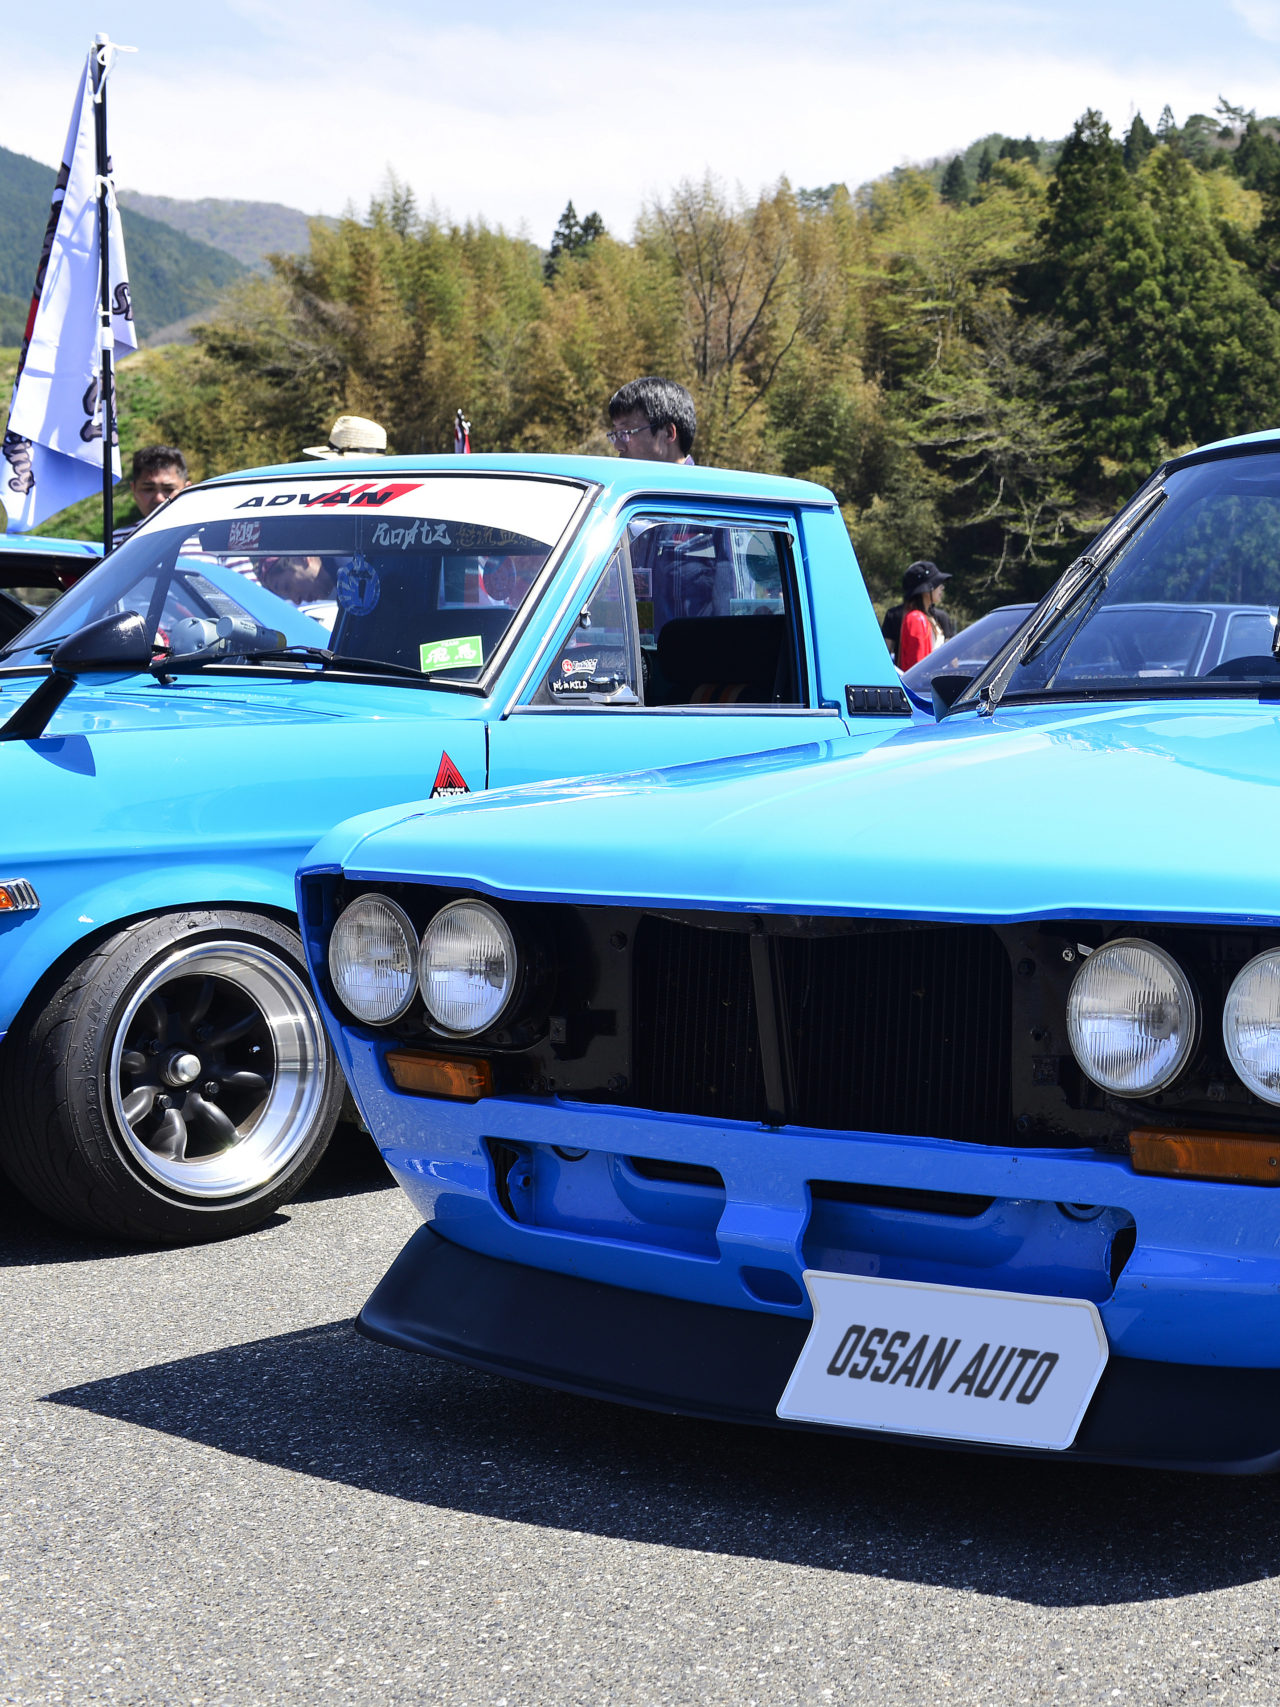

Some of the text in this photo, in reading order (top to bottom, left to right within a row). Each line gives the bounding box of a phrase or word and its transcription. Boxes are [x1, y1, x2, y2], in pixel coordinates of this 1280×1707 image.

[233, 490, 395, 509] ADVAN
[827, 1324, 1060, 1405] OSSAN AUTO
